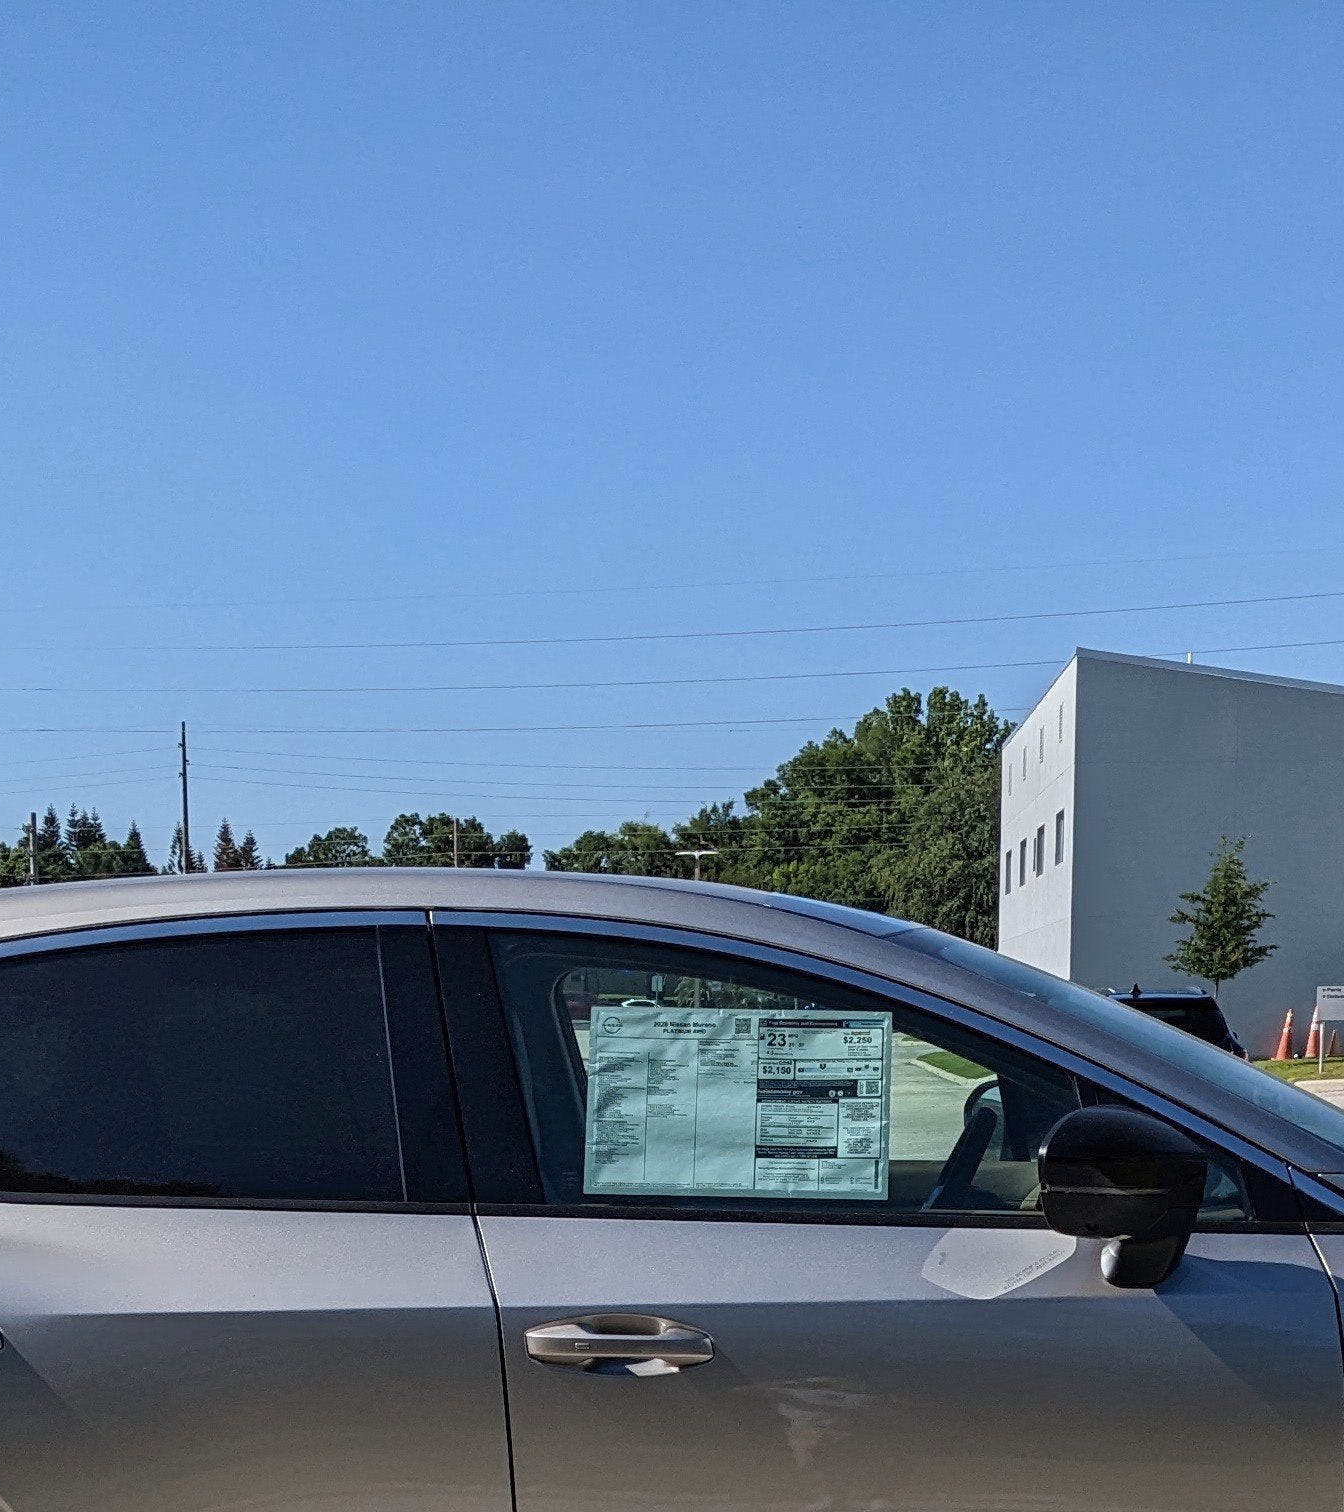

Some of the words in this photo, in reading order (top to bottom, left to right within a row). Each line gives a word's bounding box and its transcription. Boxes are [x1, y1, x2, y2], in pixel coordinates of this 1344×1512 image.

[767, 1033, 786, 1047] 23
[843, 1036, 873, 1044] $2,250
[762, 1066, 792, 1075] $2,150
